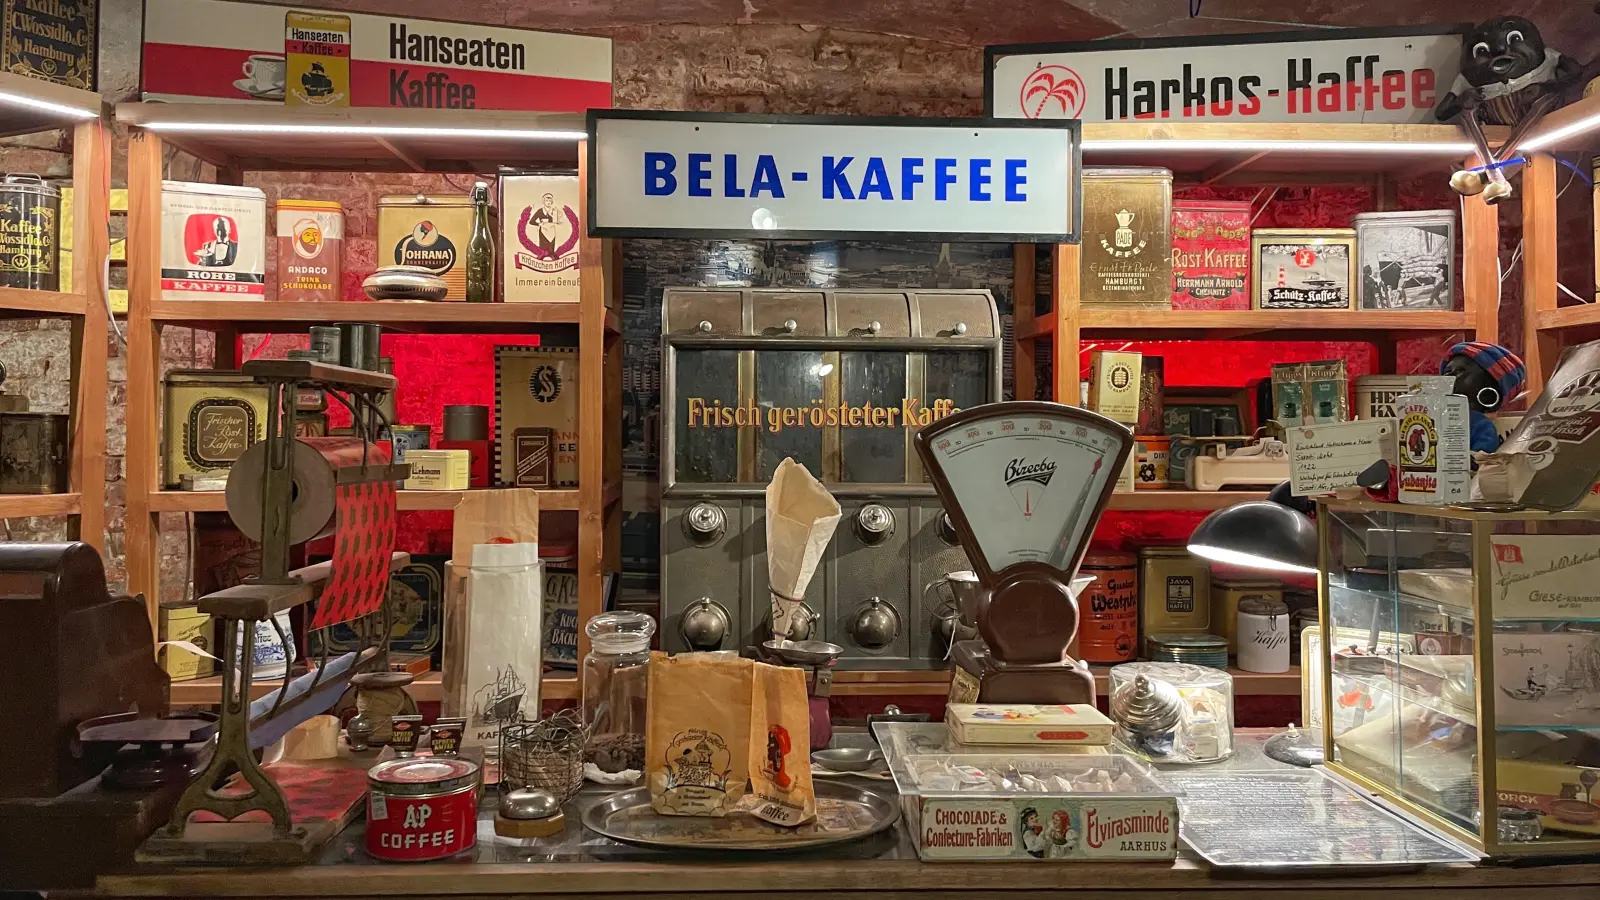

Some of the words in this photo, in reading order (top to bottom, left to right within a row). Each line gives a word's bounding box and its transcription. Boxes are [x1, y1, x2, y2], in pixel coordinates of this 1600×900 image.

[292, 28, 344, 43] Hanseaten
[24, 38, 75, 66] Hamburg
[303, 41, 333, 55] Kaffee
[389, 23, 525, 70] Hanseaten
[389, 68, 476, 108] Kaffee
[1104, 55, 1435, 120] Harkos-Kaffee
[644, 151, 1028, 202] BELA-KAFFEE
[0, 219, 42, 233] Kaffee
[1116, 232, 1131, 245] PADE
[1100, 239, 1147, 257] KAFFEE
[288, 266, 328, 274] ANDACO
[554, 256, 575, 269] Kaffee
[187, 271, 236, 281] ROHE
[516, 277, 541, 286] Immer
[544, 277, 556, 286] ein
[173, 281, 249, 292] KAFFEE
[687, 397, 761, 427] Frisch
[767, 398, 901, 432] gerösteter
[901, 397, 962, 427] Kaff
[1004, 456, 1057, 482] Bizerba
[1496, 792, 1538, 804] ORCK
[935, 808, 996, 825] CHOCOLADE
[998, 811, 1007, 825] &
[1086, 809, 1169, 849] Elvirasminde
[381, 829, 454, 849] COFFEE
[1120, 840, 1167, 851] AARHUS
